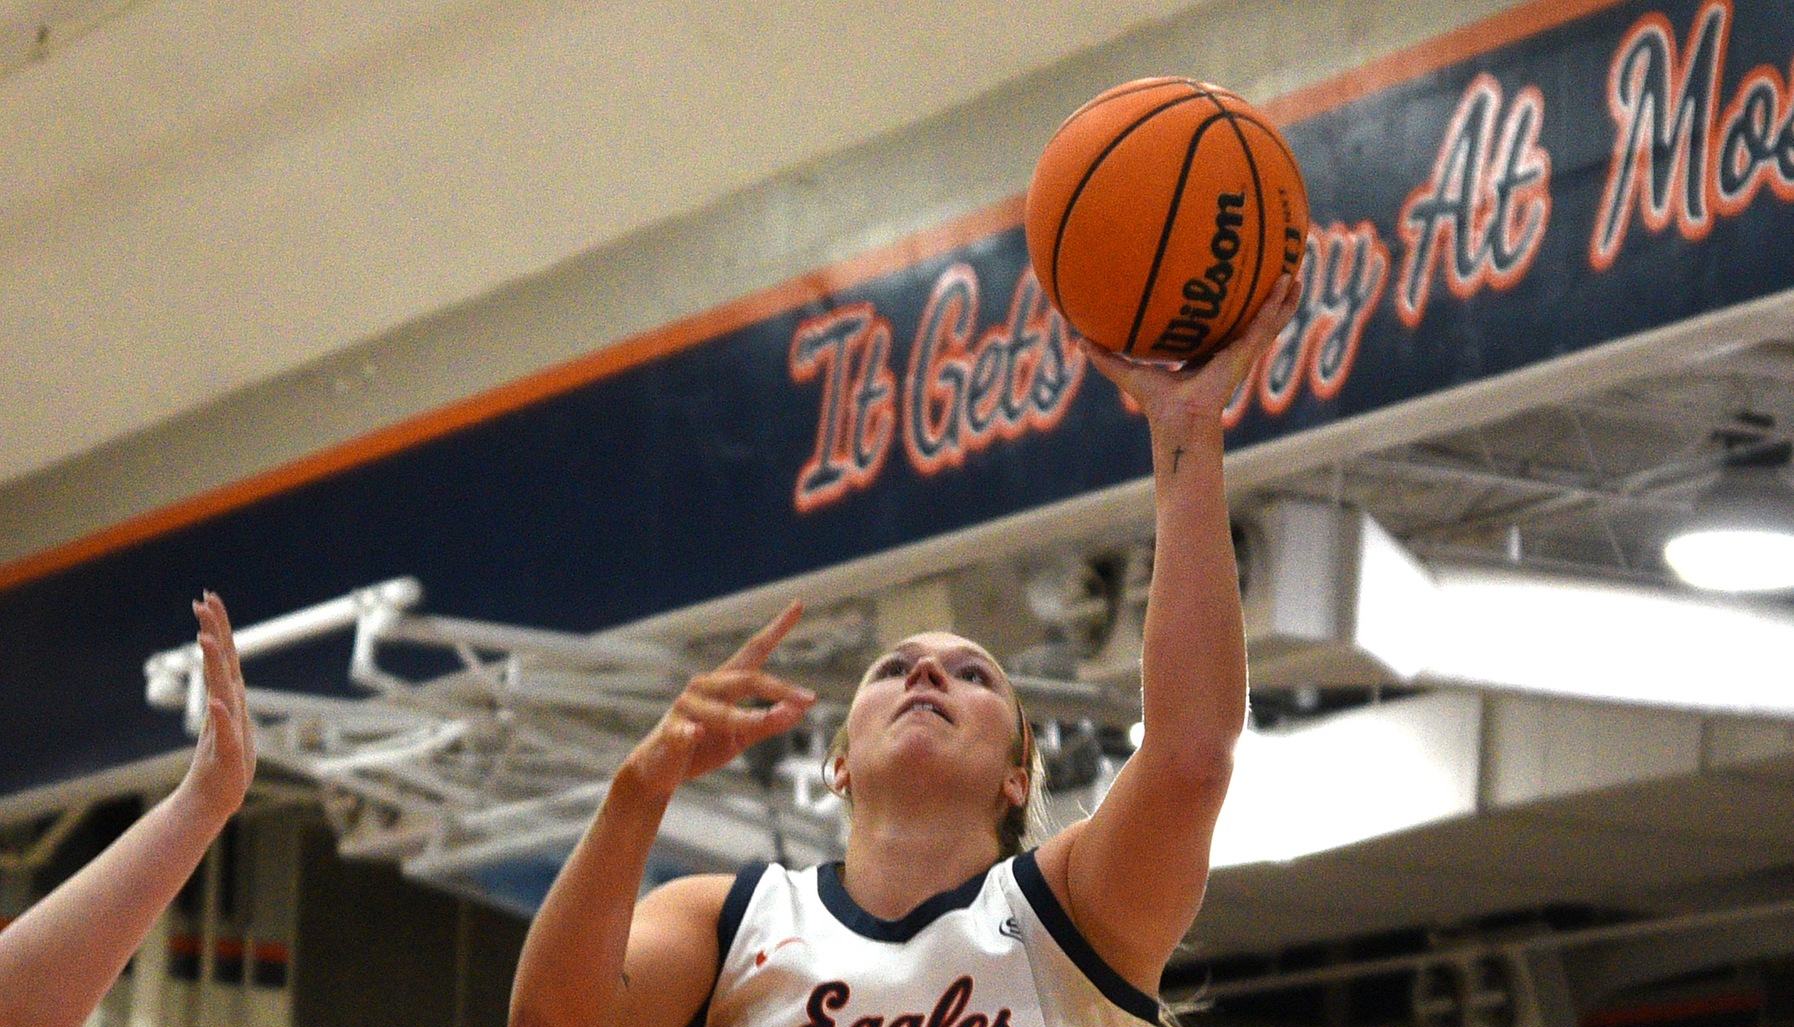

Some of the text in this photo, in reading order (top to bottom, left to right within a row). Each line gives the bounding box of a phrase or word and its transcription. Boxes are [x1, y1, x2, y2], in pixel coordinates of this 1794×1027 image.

[790, 302, 897, 511] It
[904, 263, 1087, 476] Gets
[1397, 73, 1551, 327] At
[1590, 0, 1794, 270] Mo
[1153, 191, 1246, 354] Wilson
